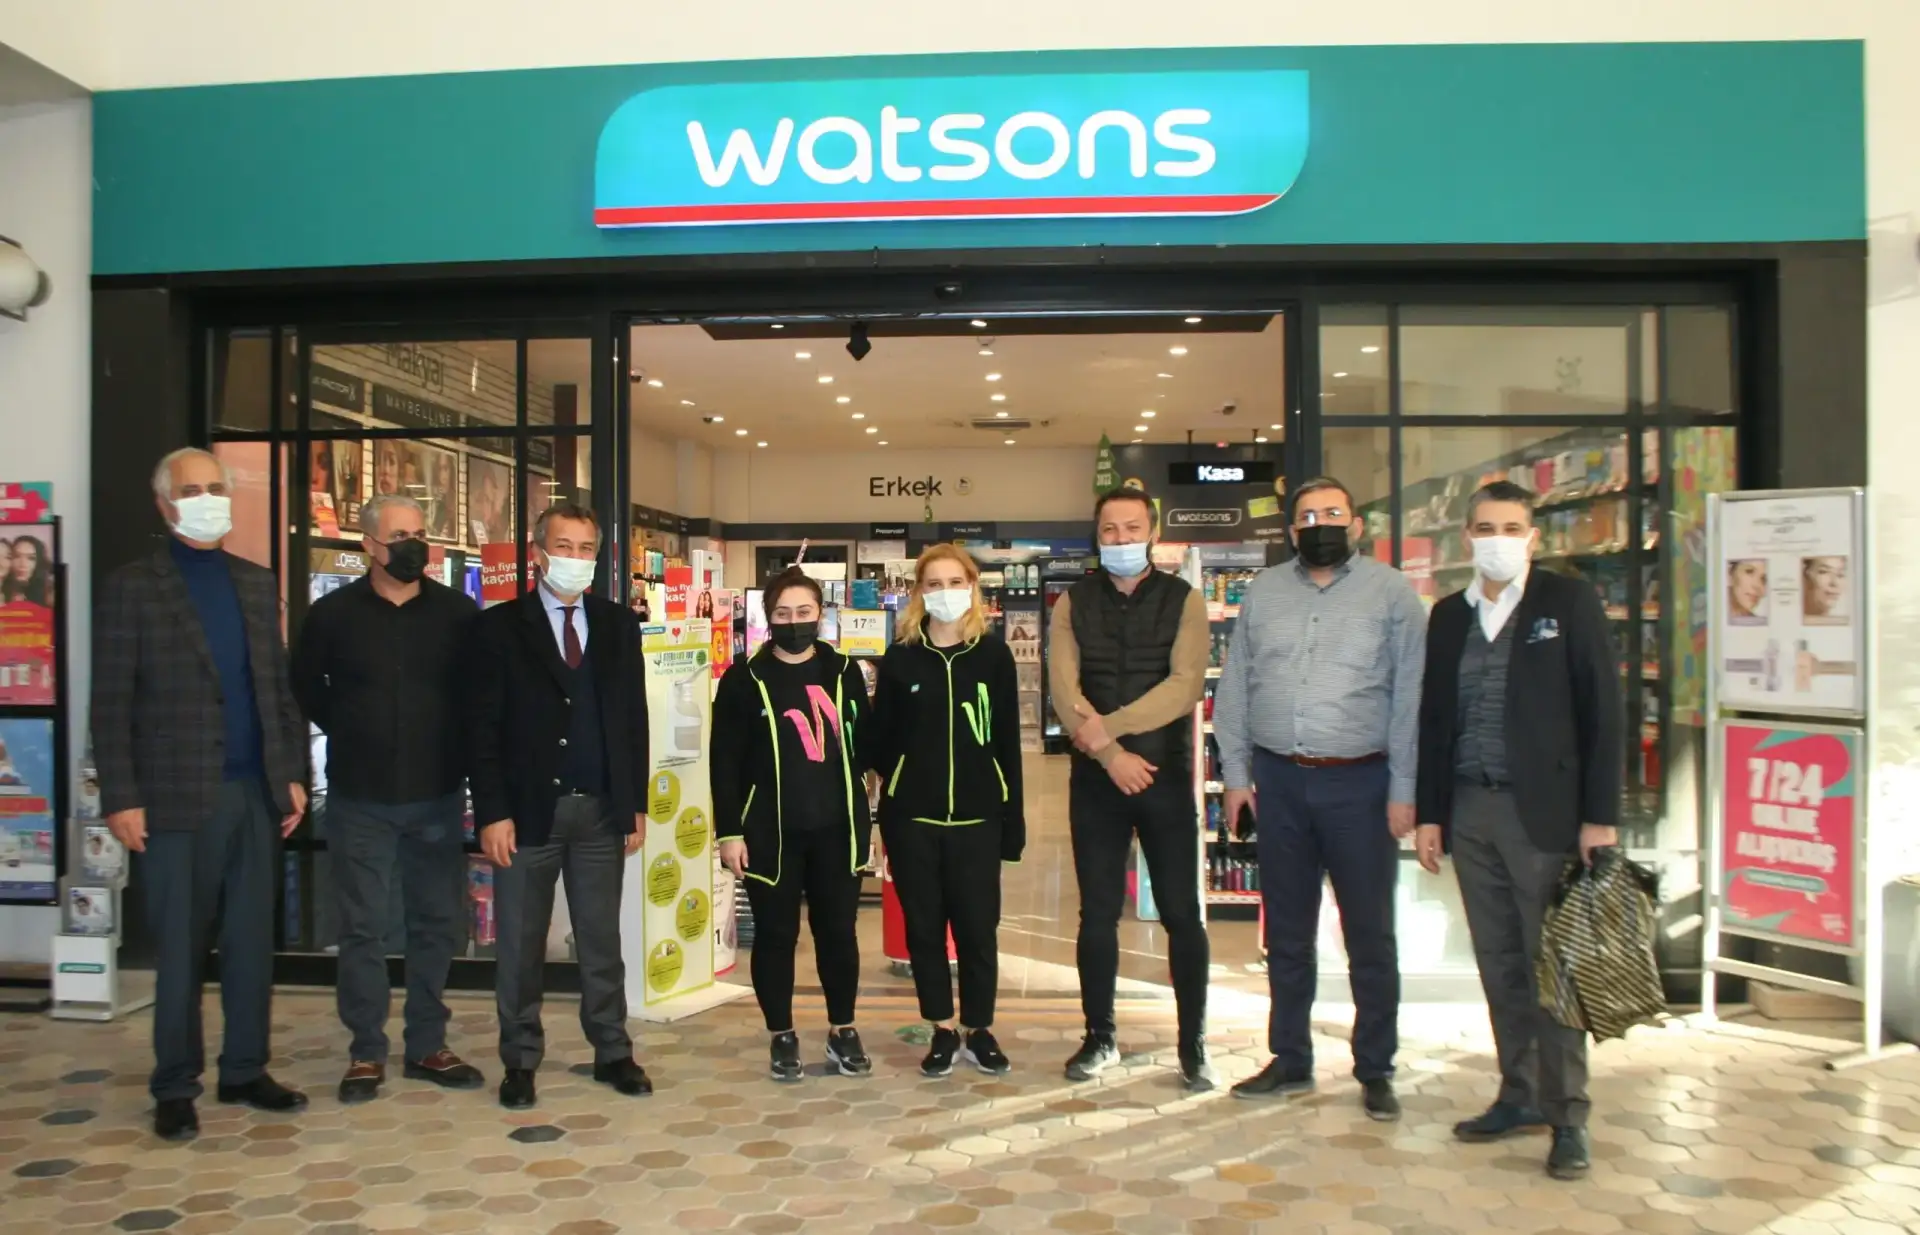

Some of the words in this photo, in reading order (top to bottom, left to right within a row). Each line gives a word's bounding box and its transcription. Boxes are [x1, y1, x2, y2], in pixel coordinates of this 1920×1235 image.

[686, 105, 1217, 188] watsons
[385, 393, 452, 427] MAYBELLINE
[1198, 465, 1244, 481] Kasa
[868, 475, 943, 497] Erkek
[1176, 512, 1232, 522] watsons
[482, 564, 497, 573] bu
[481, 570, 535, 586] kaçmz
[852, 617, 868, 629] 17
